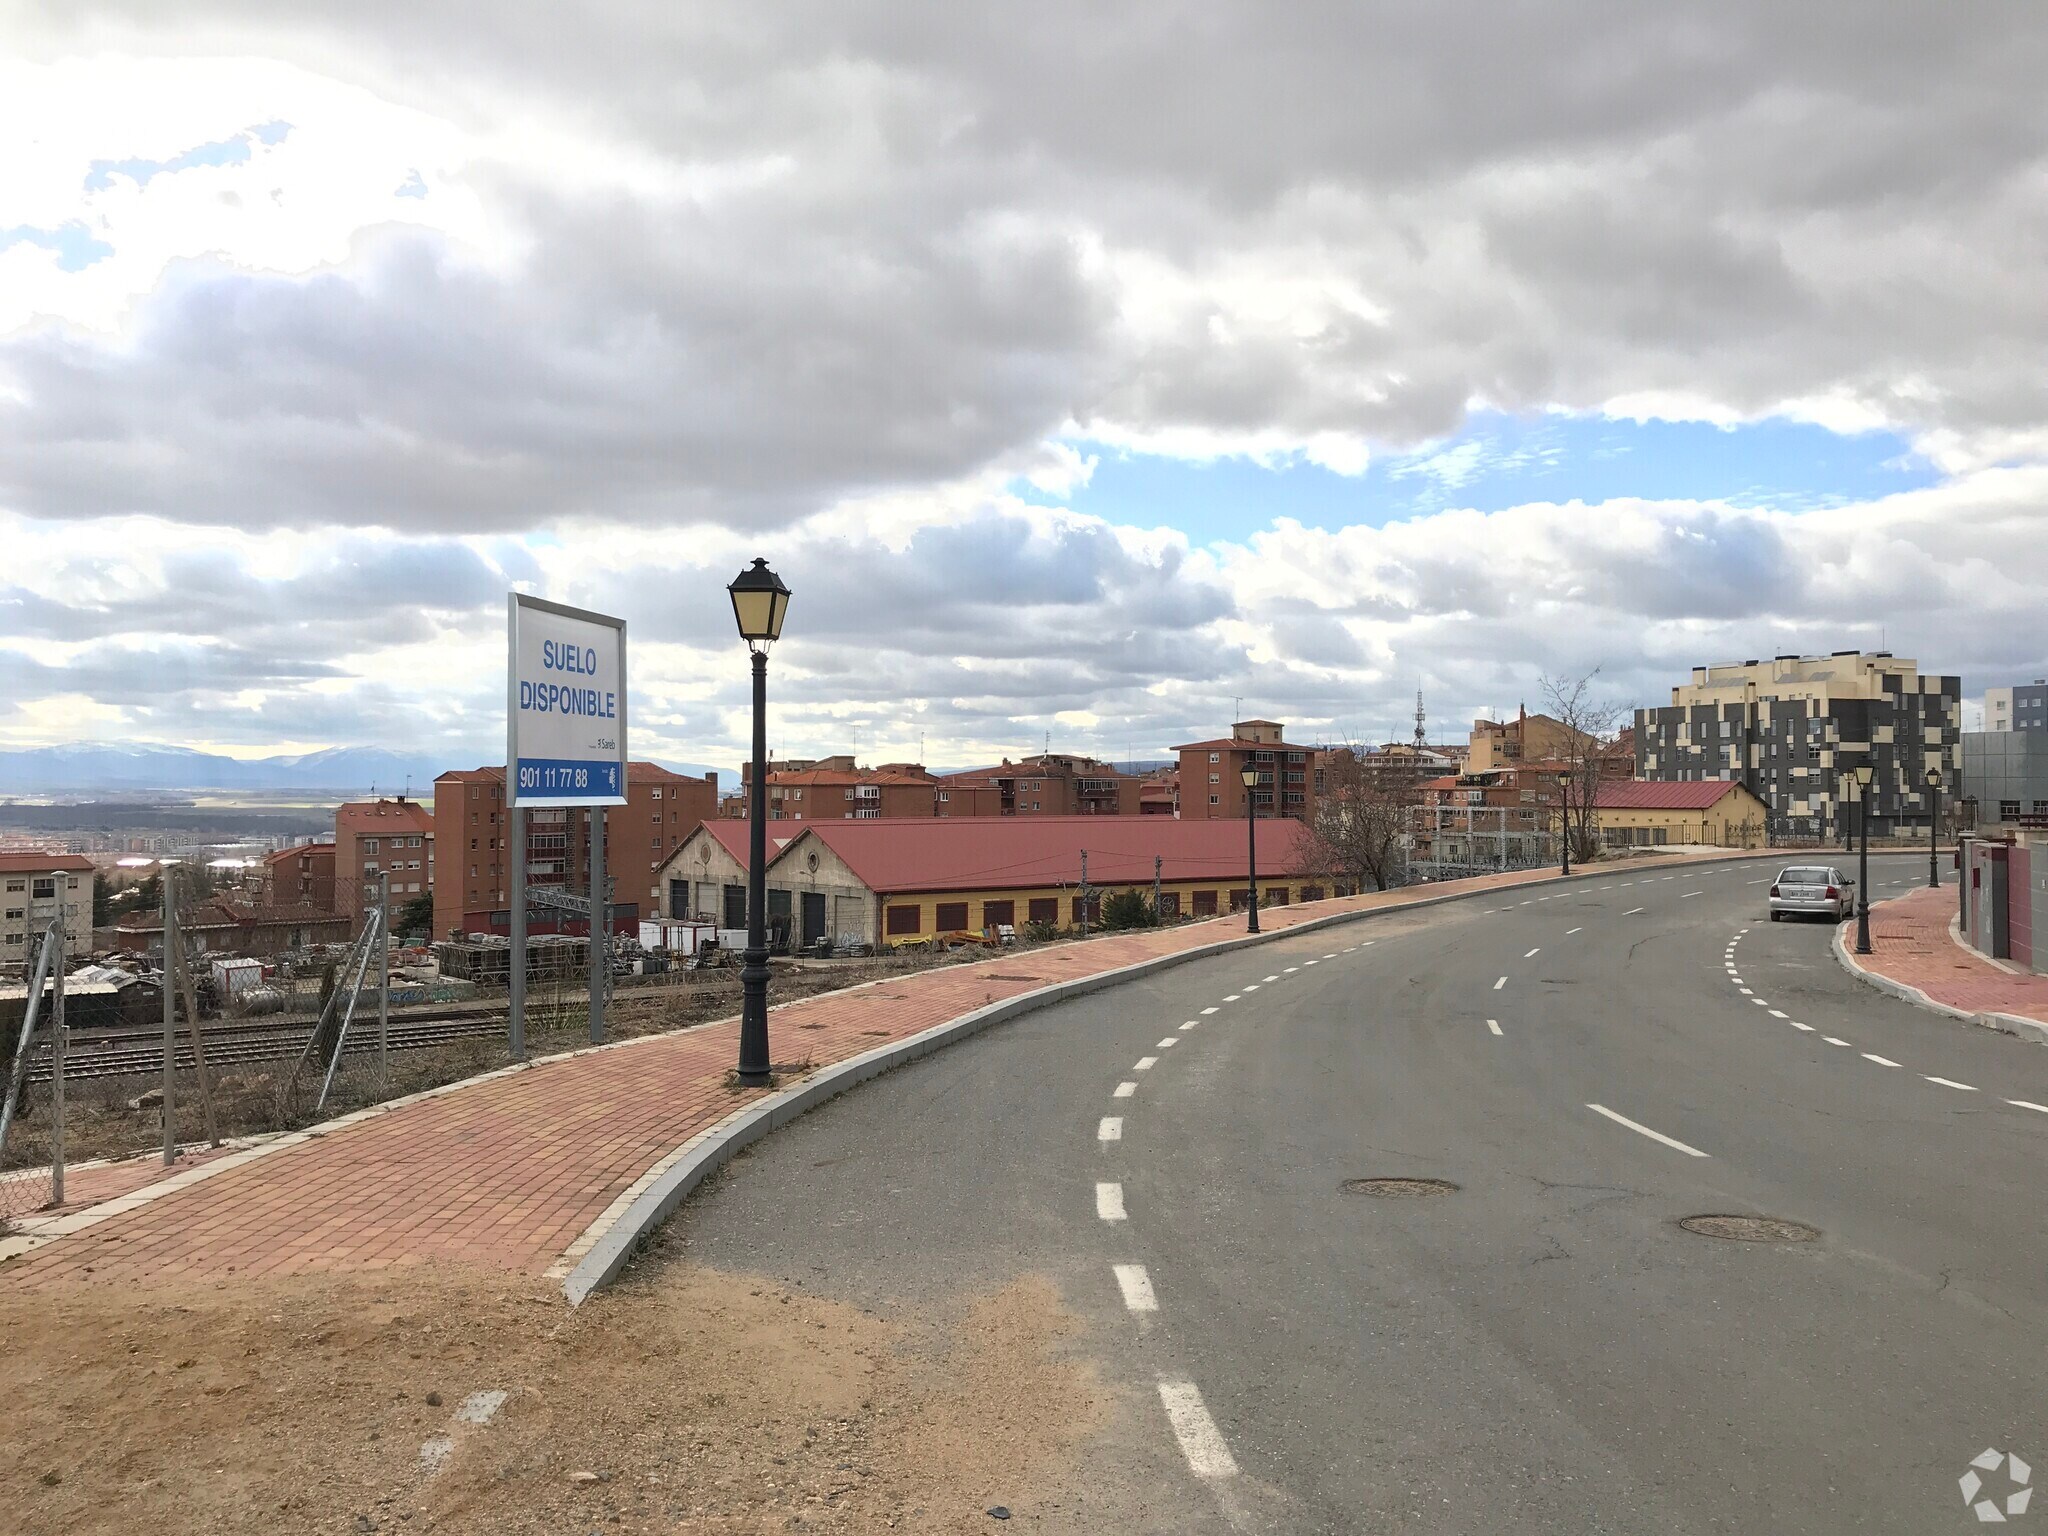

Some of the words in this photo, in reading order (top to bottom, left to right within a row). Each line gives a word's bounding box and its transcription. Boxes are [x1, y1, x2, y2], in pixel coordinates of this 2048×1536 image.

[543, 639, 596, 675] SUELO
[520, 680, 615, 718] DISPONIBLE
[602, 738, 615, 750] Sareb
[520, 767, 540, 788] 901
[545, 767, 556, 788] 11
[559, 768, 572, 788] 77
[575, 768, 588, 788] 88
